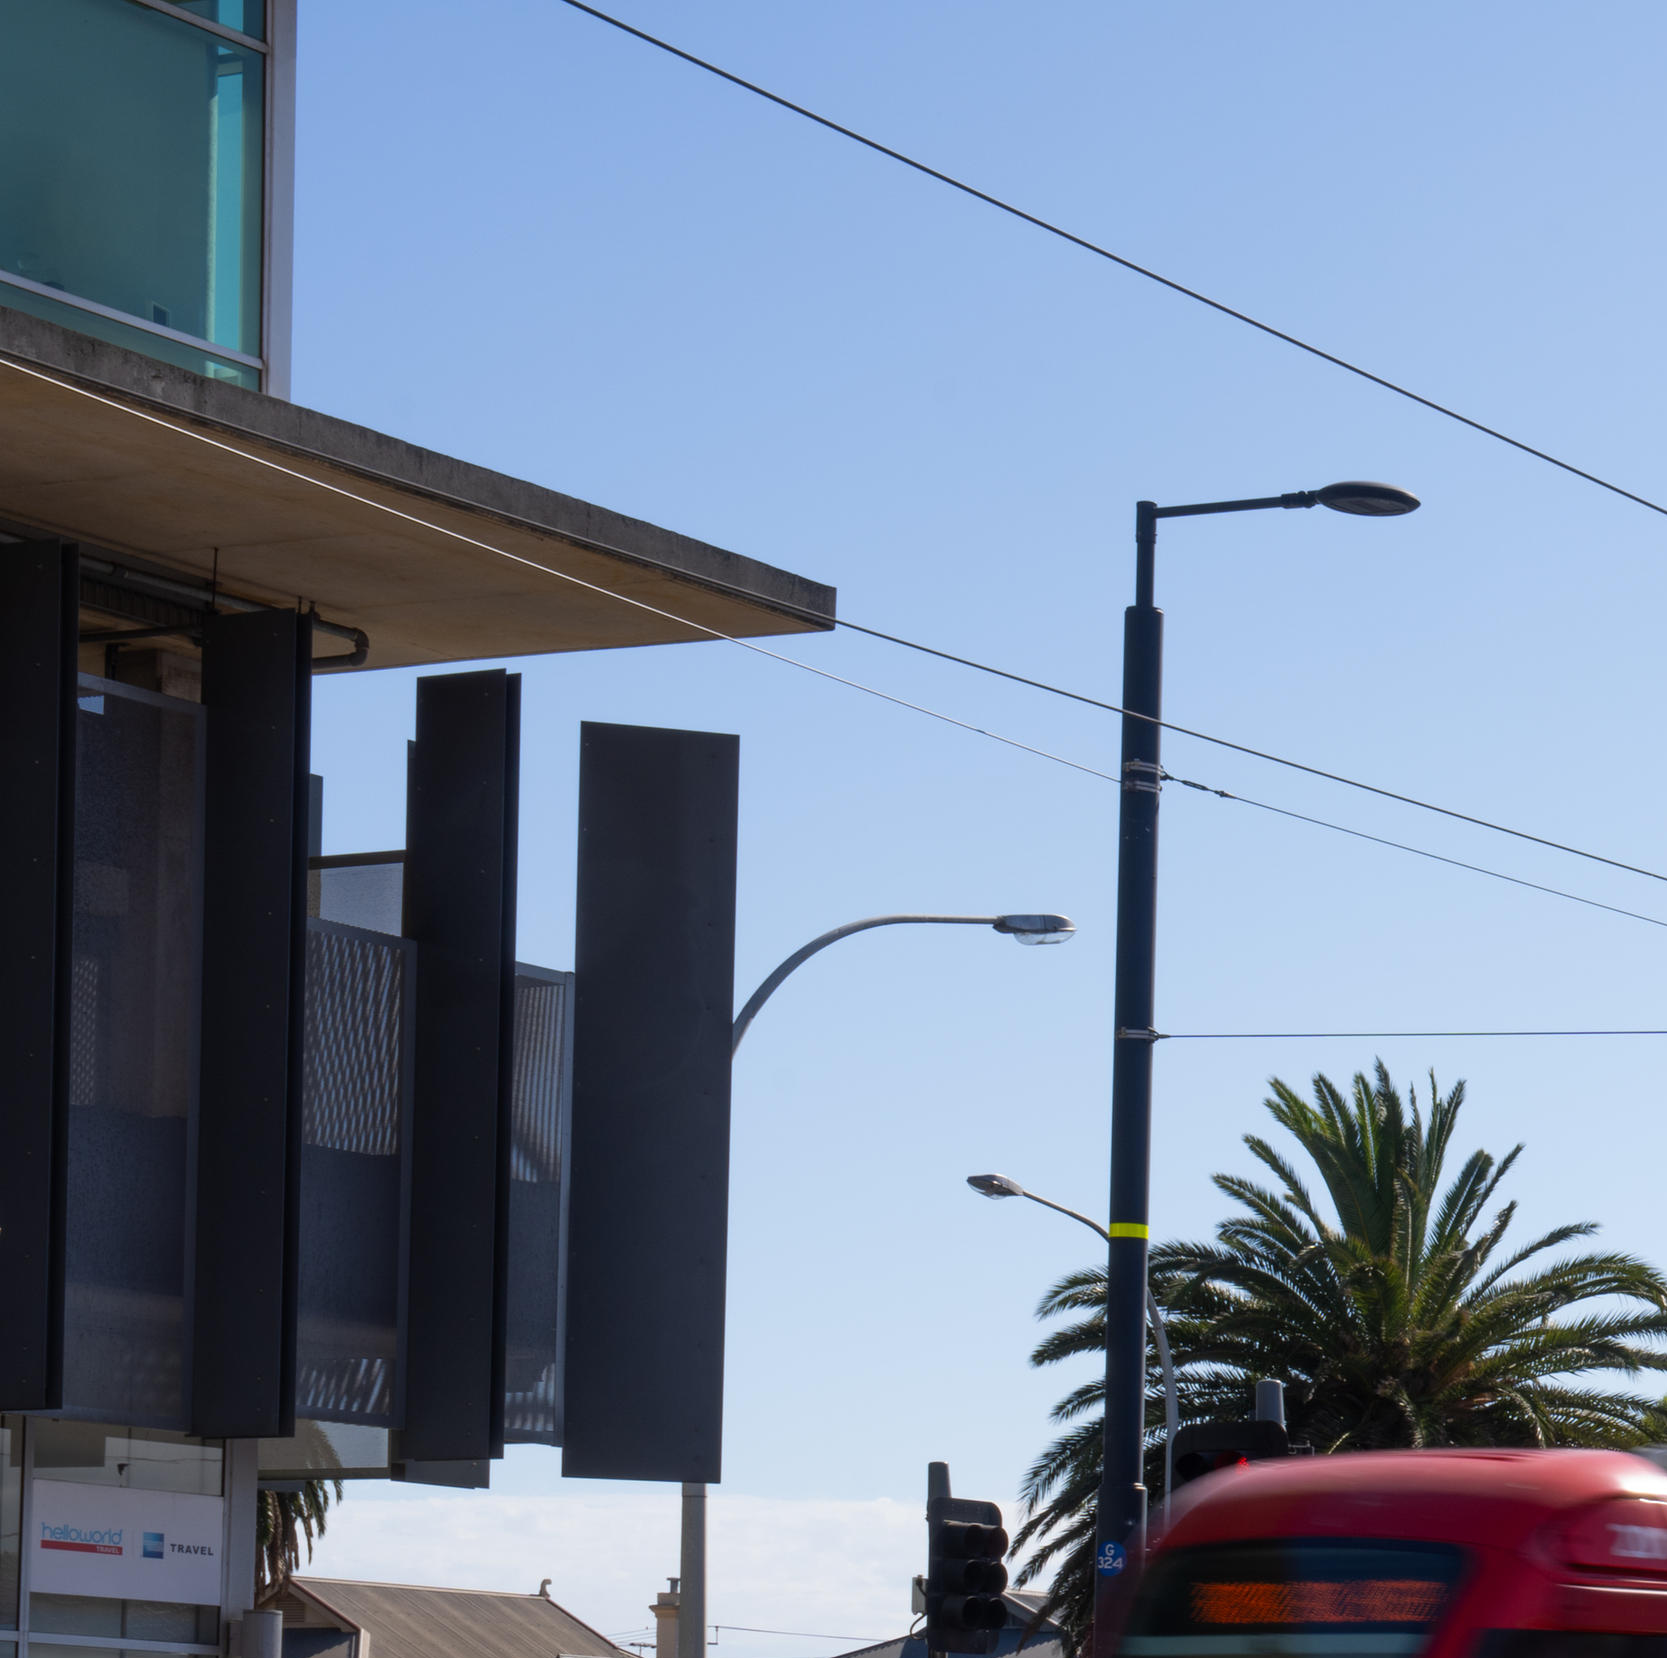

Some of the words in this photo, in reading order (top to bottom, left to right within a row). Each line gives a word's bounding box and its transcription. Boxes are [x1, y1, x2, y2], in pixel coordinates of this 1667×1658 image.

[40, 1522, 123, 1545] helloworld
[170, 1543, 214, 1556] TRAVEL
[1105, 1544, 1115, 1556] G
[1098, 1556, 1123, 1569] 324
